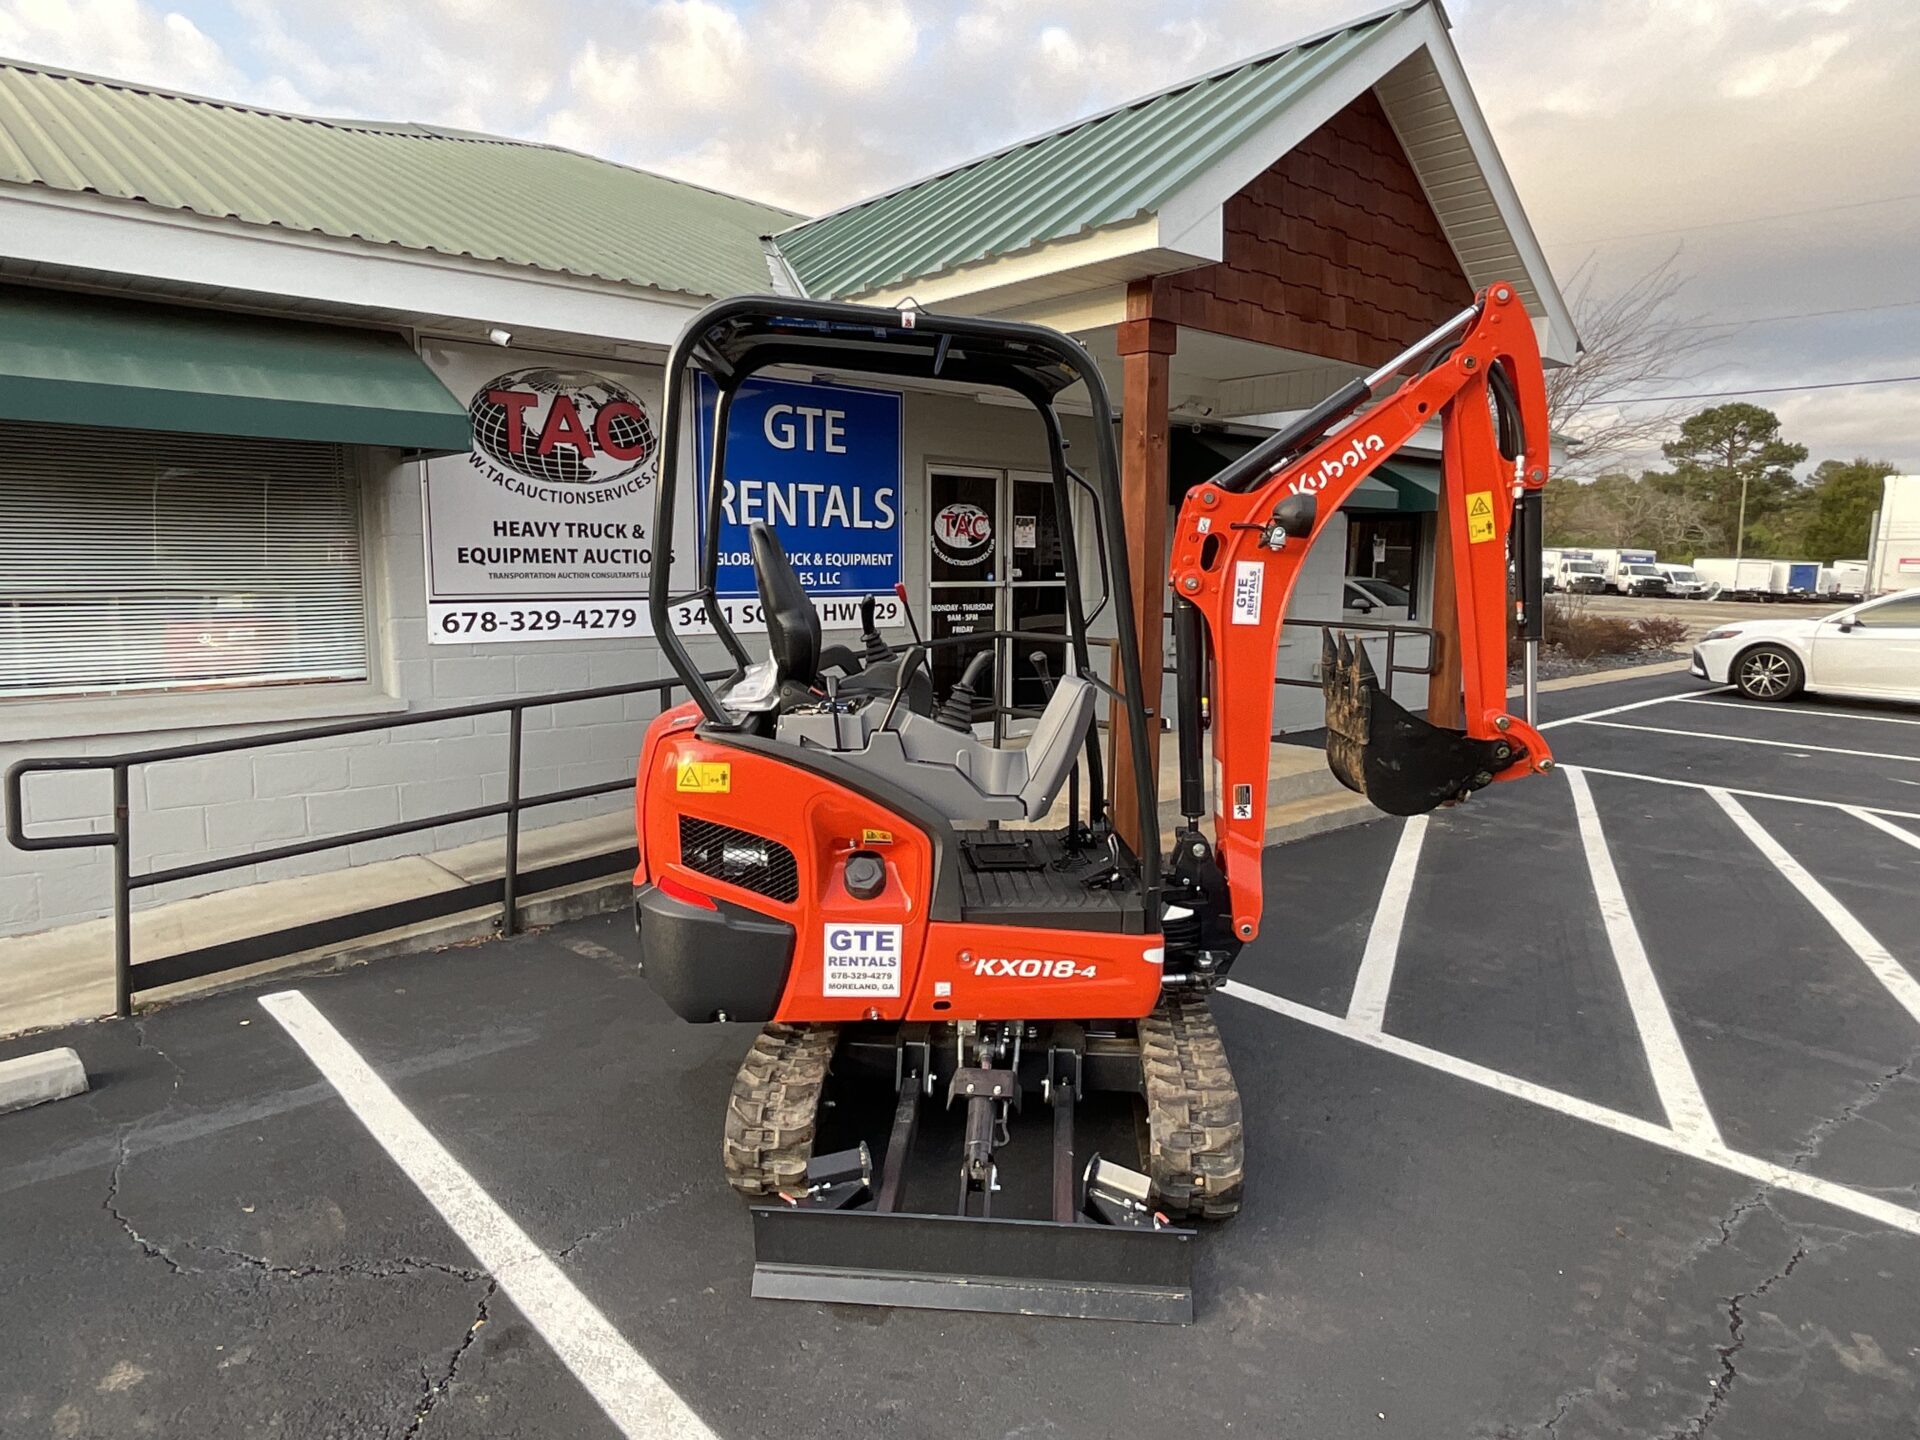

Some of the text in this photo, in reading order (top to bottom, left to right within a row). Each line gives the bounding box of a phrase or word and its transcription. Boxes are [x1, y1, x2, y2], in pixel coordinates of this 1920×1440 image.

[489, 391, 643, 461] TAC
[763, 404, 847, 454] GTE
[1288, 434, 1385, 496] Kubota
[721, 479, 895, 529] RENTALS
[493, 520, 645, 540] HEAVY TRUCK &
[941, 513, 988, 539] TAC
[457, 547, 675, 566] EQUIPMENT AUCTIOS
[717, 552, 754, 566] GLOB
[813, 553, 823, 566] &
[825, 553, 893, 566] EQUIPMENT
[488, 572, 556, 580] TRANSPORTATION
[819, 572, 841, 585] LLC
[1236, 578, 1248, 608] GTE
[1246, 570, 1257, 616] RENTALS
[875, 603, 897, 620] 29
[931, 604, 958, 612] MONDAY
[962, 603, 993, 611] THURSDAY
[441, 608, 637, 634] 678-329-4279
[679, 606, 733, 626] 341
[952, 626, 974, 634] FRIDAY
[830, 929, 895, 951] GTE
[828, 956, 897, 967] RENTALS
[974, 958, 1097, 978] KX018-4
[831, 972, 893, 980] 678-329-4279
[828, 983, 880, 991] MORELAND,
